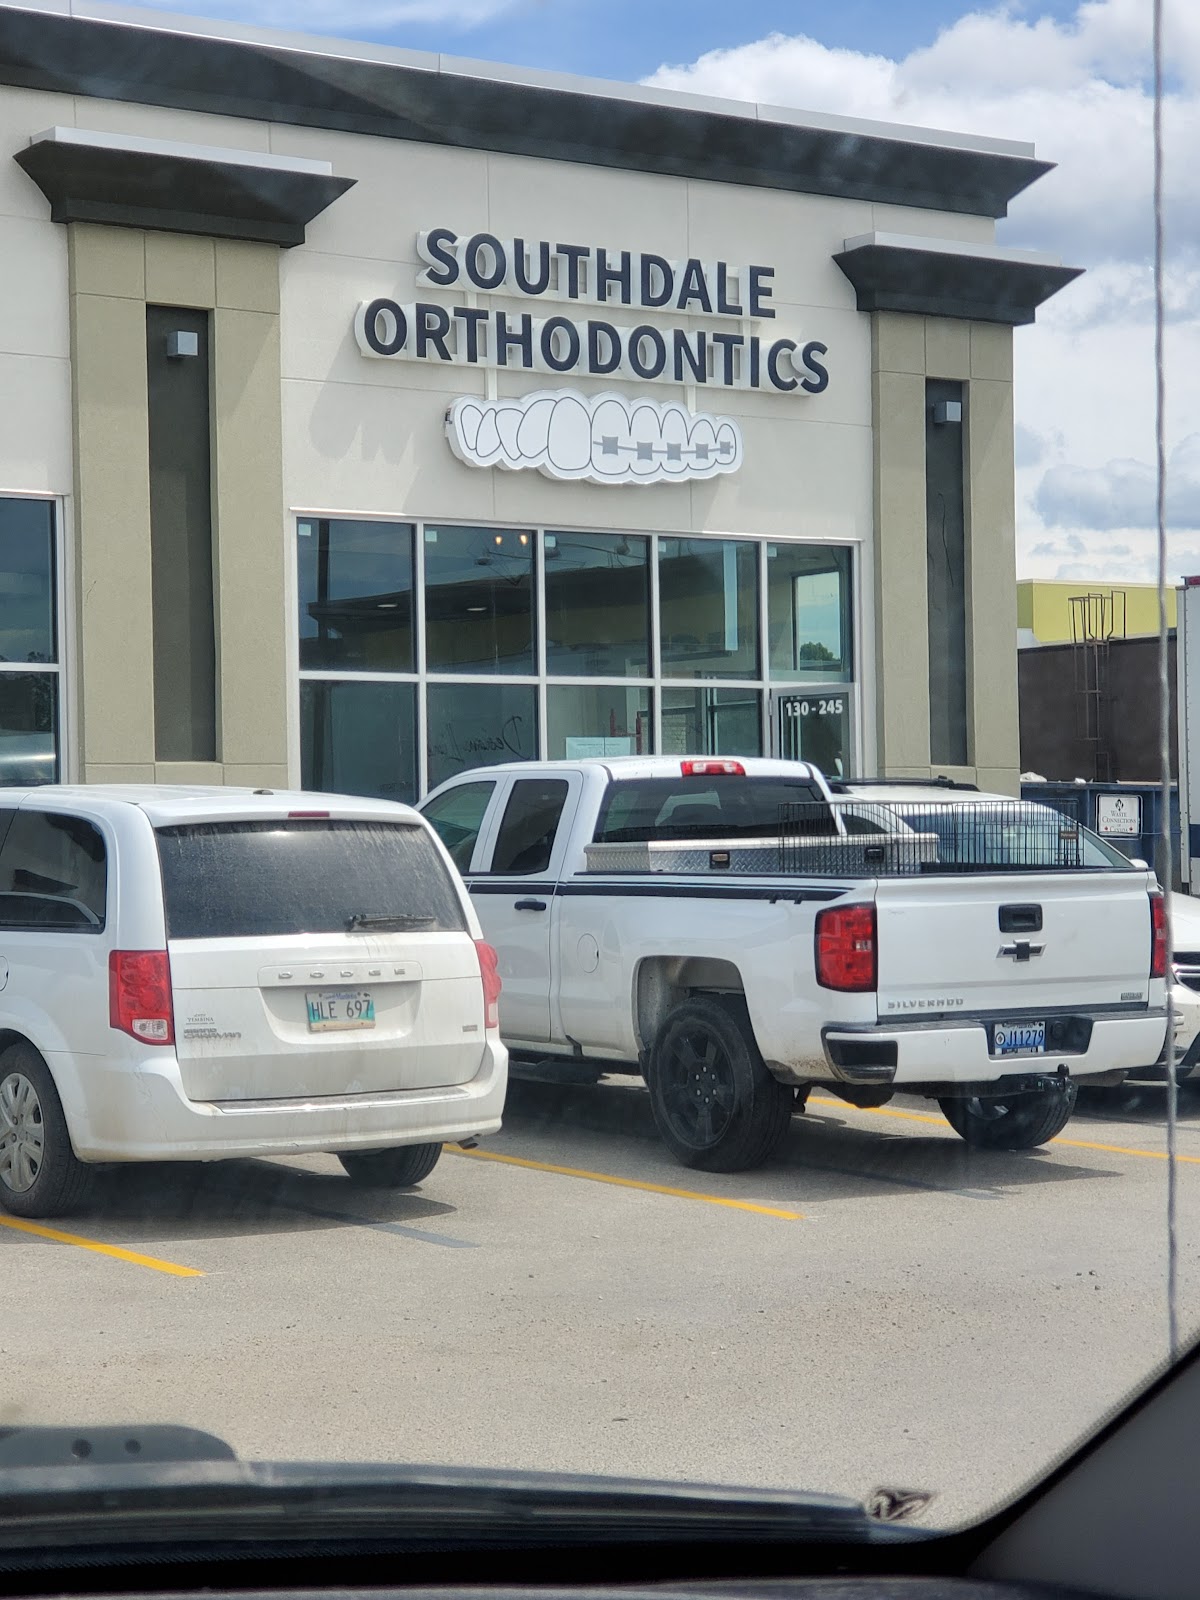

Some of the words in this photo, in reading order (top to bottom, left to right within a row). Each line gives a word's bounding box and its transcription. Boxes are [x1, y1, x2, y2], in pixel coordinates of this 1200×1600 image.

[425, 227, 776, 319] SOUTHDALE
[363, 297, 830, 394] ORTHODONTICS
[785, 701, 809, 717] 130
[818, 699, 843, 715] 245
[1101, 815, 1137, 824] CONNECTIONS
[278, 967, 406, 980] DODGE
[311, 1001, 338, 1020] HLE
[346, 999, 370, 1018] 697
[887, 998, 964, 1009] SILVERADO
[1006, 1029, 1044, 1047] J11279
